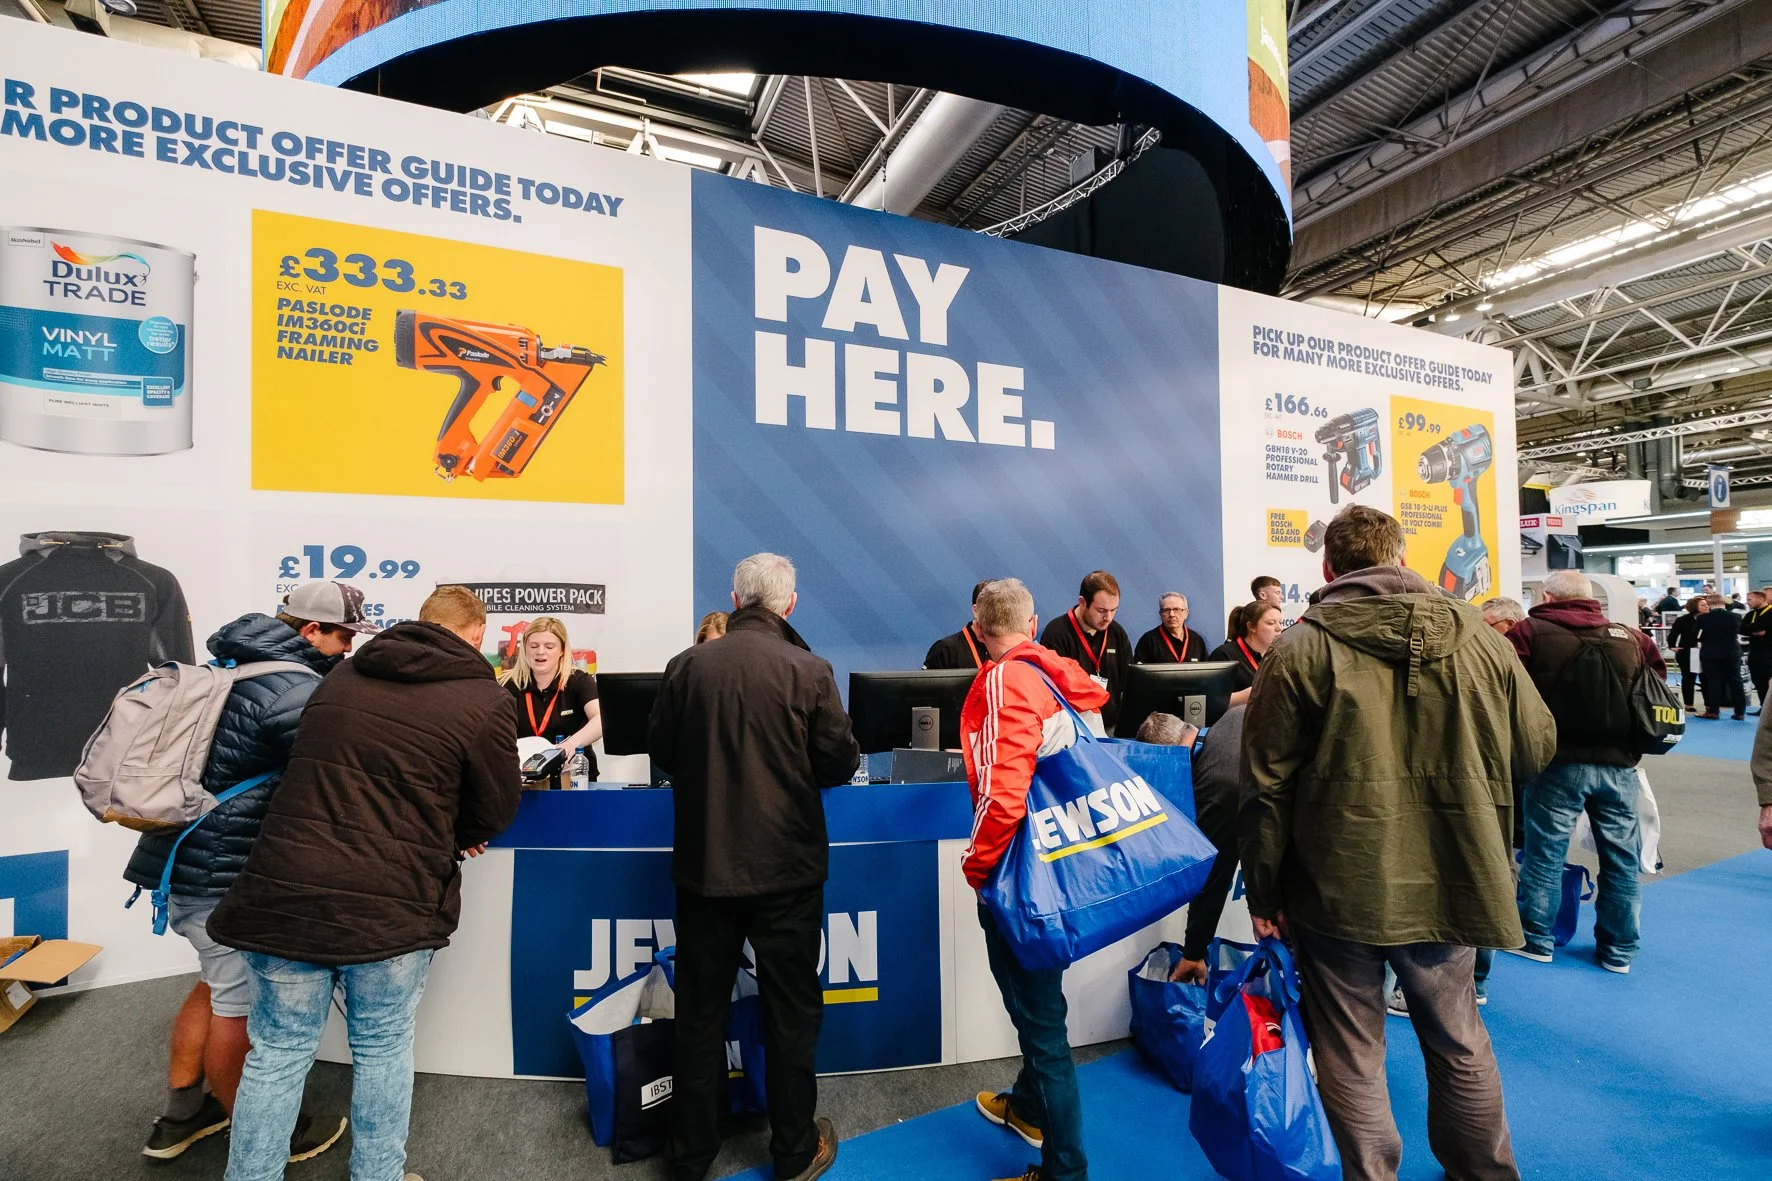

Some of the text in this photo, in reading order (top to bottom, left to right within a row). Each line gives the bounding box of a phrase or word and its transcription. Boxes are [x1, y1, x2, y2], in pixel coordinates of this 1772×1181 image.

[50, 86, 264, 151] PRODUCT
[271, 131, 392, 175] OFFER
[400, 155, 513, 197] GUIDE
[517, 177, 625, 218] TODAY
[0, 108, 522, 224] MORE EXCLUSIVE OFFERS.
[52, 260, 139, 288] Dulux
[279, 247, 468, 301] £333.33
[43, 279, 147, 307] TRADE
[276, 280, 327, 295] EXC. VAT
[754, 225, 971, 346] PAY
[277, 297, 373, 321] PASLODE
[277, 313, 367, 336] IM360Ci
[41, 325, 118, 347] VINYL
[277, 329, 379, 353] FRAMING
[42, 342, 115, 362] MATT
[277, 345, 354, 366] NAILER
[1252, 325, 1493, 385] PICK UP OUR PRODUCT OFFER GUIDE TODAY
[1253, 340, 1464, 392] FOR MANY MORE EXCLUSIVE OFFERS.
[754, 330, 1056, 450] HERE.
[1265, 392, 1328, 419] £166.66
[1398, 412, 1441, 434] £99.99
[1277, 429, 1303, 440] BOSCH
[1265, 444, 1308, 456] GBH18 V-20
[1265, 453, 1318, 466] PROFESSIONAL
[1266, 463, 1294, 473] ROTARY
[1266, 472, 1319, 484] HAMMER DRILL
[1409, 489, 1430, 499] BOSCH
[1270, 512, 1286, 520] FREE
[1400, 510, 1443, 520] PROFESSIONAL
[1555, 501, 1617, 516] Kingspan
[1270, 520, 1293, 528] BOSCH
[1401, 519, 1443, 528] 18 VOLT COMBI
[1520, 519, 1537, 527] LUX
[1270, 535, 1302, 544] CHARGER
[278, 544, 421, 580] £19.99
[515, 588, 567, 604] POWER
[569, 589, 603, 605] PACK
[486, 603, 575, 612] BILE CLEANING SYSTEM
